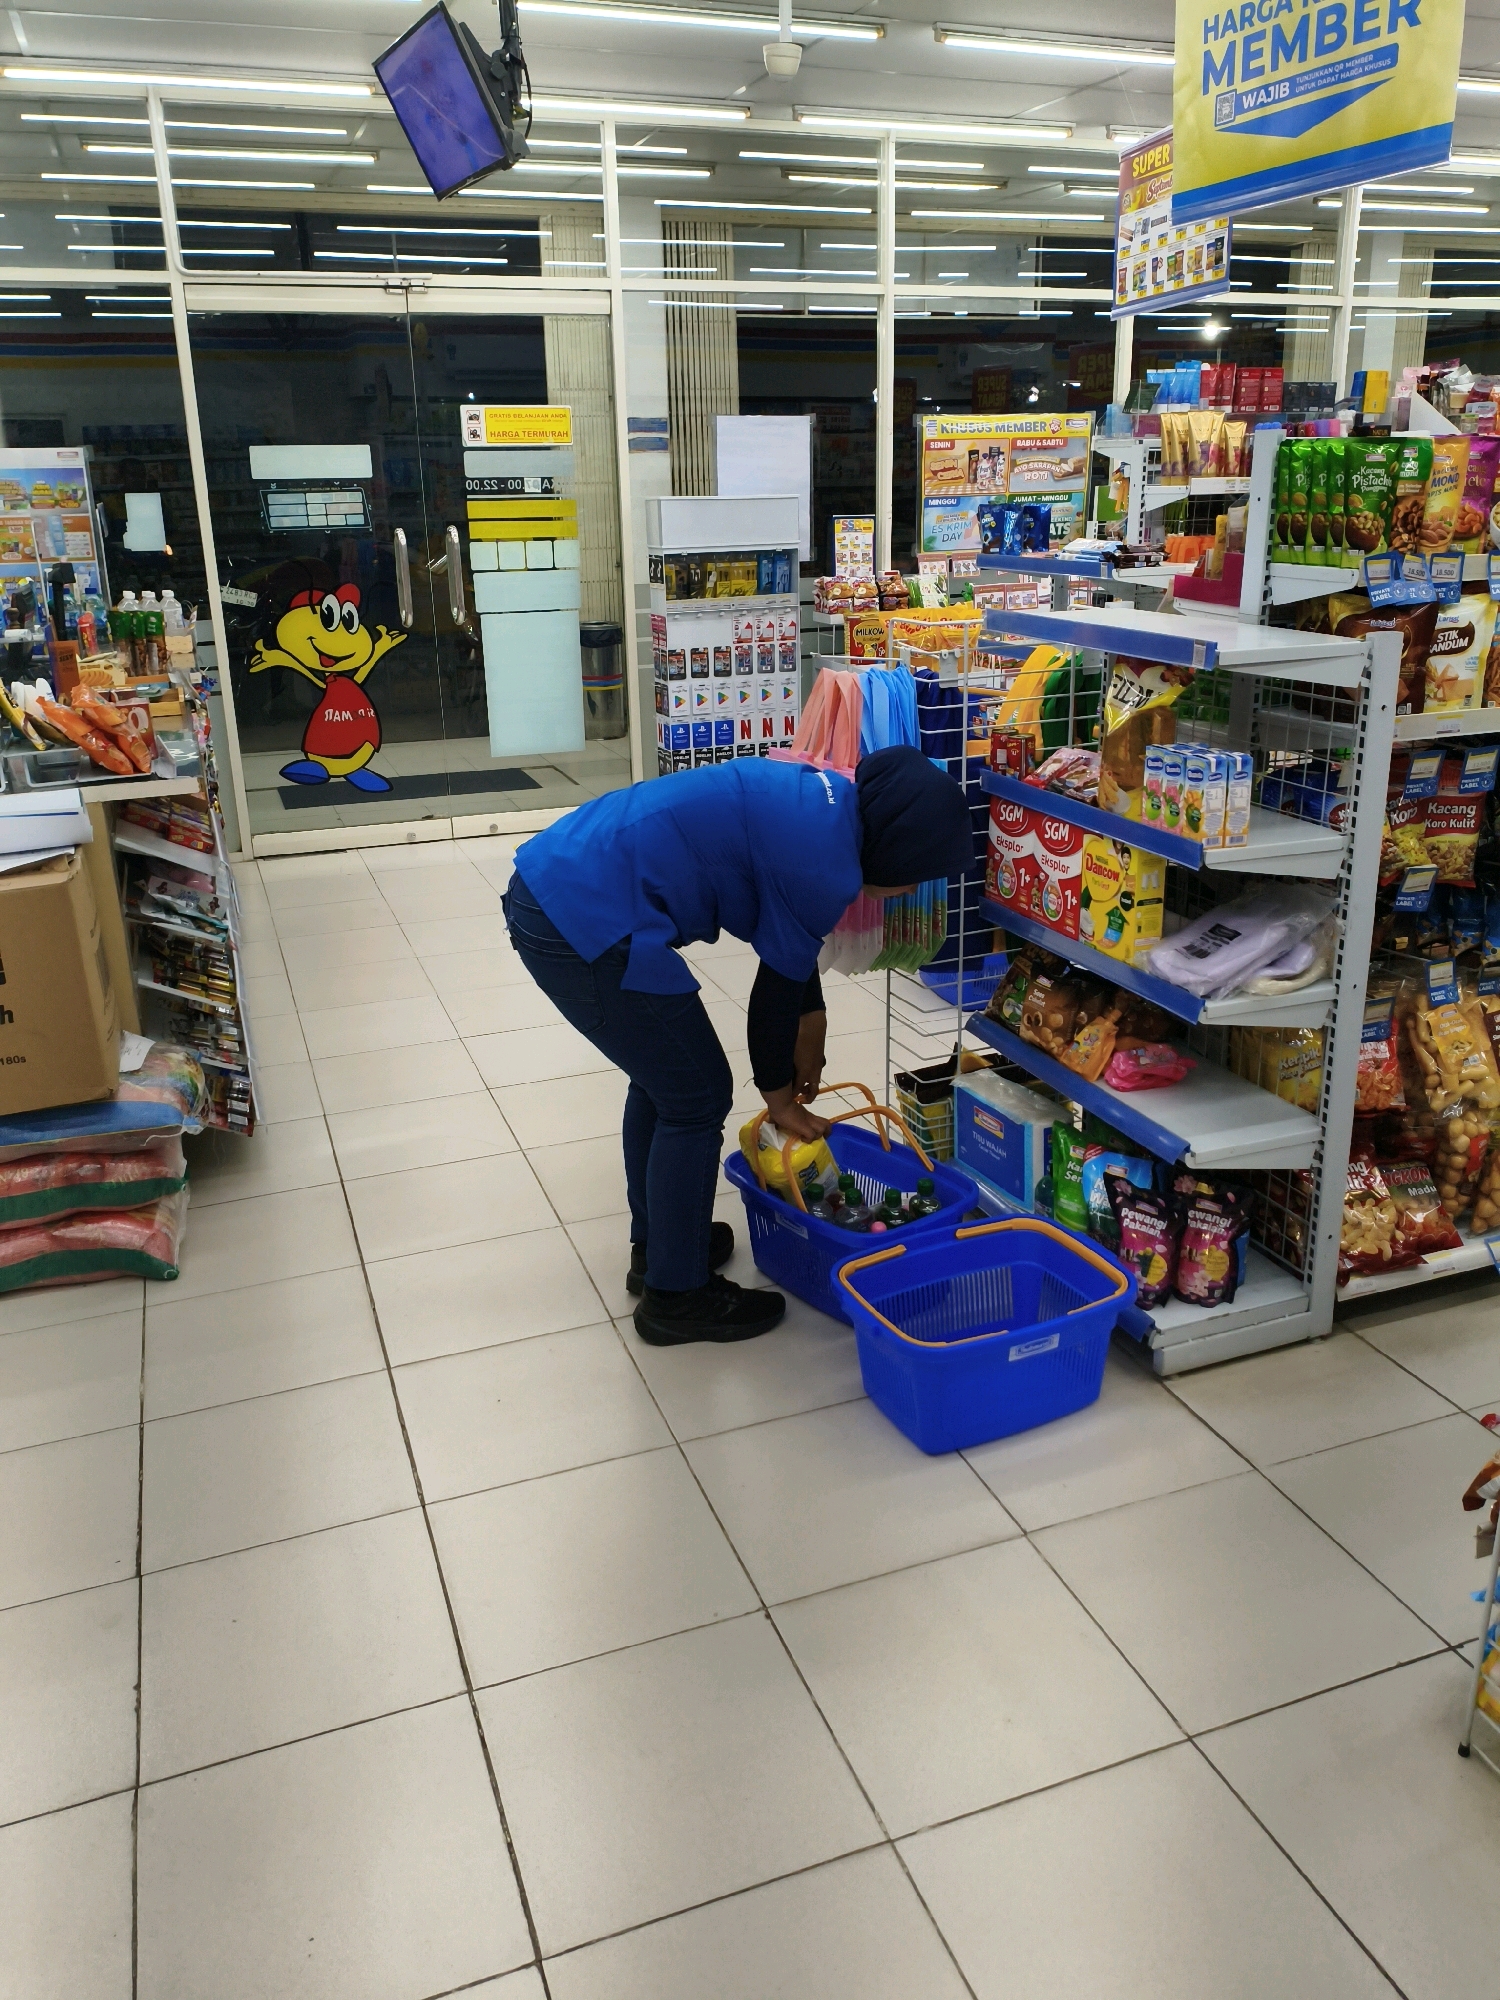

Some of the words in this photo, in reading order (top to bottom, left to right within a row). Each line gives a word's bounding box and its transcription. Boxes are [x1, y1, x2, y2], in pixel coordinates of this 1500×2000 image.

[1203, 0, 1294, 45] HARGA
[1202, 0, 1422, 96] MEMBER
[1295, 67, 1334, 84] TUNJUKKAN
[1334, 63, 1344, 73] QR
[1345, 54, 1374, 69] MEMBER
[1295, 81, 1317, 93] UNTUK
[1317, 75, 1339, 88] DAPAT
[1340, 67, 1363, 80] HARGA
[1364, 58, 1392, 73] KHUSUS
[1242, 81, 1290, 110] WAJIB
[1132, 143, 1170, 178] SUPER
[490, 430, 520, 438] HARGA
[521, 430, 569, 438] TERMURAH
[941, 421, 993, 434] KHUSUS
[995, 420, 1047, 433] MEMBER
[1016, 439, 1036, 447] RABU
[1042, 438, 1064, 446] SABTU
[1024, 470, 1049, 480] ROTI
[1360, 465, 1386, 476] Kacang
[928, 498, 957, 506] MINGGU
[931, 523, 944, 534] ES
[945, 520, 972, 532] KRIM
[941, 531, 962, 543] DAY
[1408, 567, 1426, 577] 18.500
[1370, 587, 1391, 596] PRIVATE
[1371, 592, 1392, 602] LABEL
[1437, 629, 1459, 643] STIK
[1429, 637, 1469, 654] ANDUM
[741, 719, 752, 740] N
[762, 717, 774, 738] N
[784, 715, 795, 736] N
[999, 804, 1024, 823] SGM
[1428, 802, 1477, 818] Kacang
[1044, 820, 1070, 842] SGM
[1424, 818, 1447, 829] Koro
[1449, 818, 1475, 829] Kulit
[996, 835, 1024, 853] Eksplor
[1041, 853, 1071, 875] Eksplor
[1085, 853, 1120, 882] Dancow
[1019, 867, 1031, 887] 1+
[1064, 889, 1078, 910] 1+
[1395, 899, 1414, 907] LABEL
[1431, 994, 1447, 1002] LABEL
[972, 1130, 986, 1145] TISU
[986, 1139, 1007, 1158] WAJAH
[1407, 1185, 1437, 1197] Madu
[1121, 1207, 1168, 1230] Pewangi
[1187, 1208, 1233, 1228] ewangi
[1123, 1218, 1161, 1237] Pakaian
